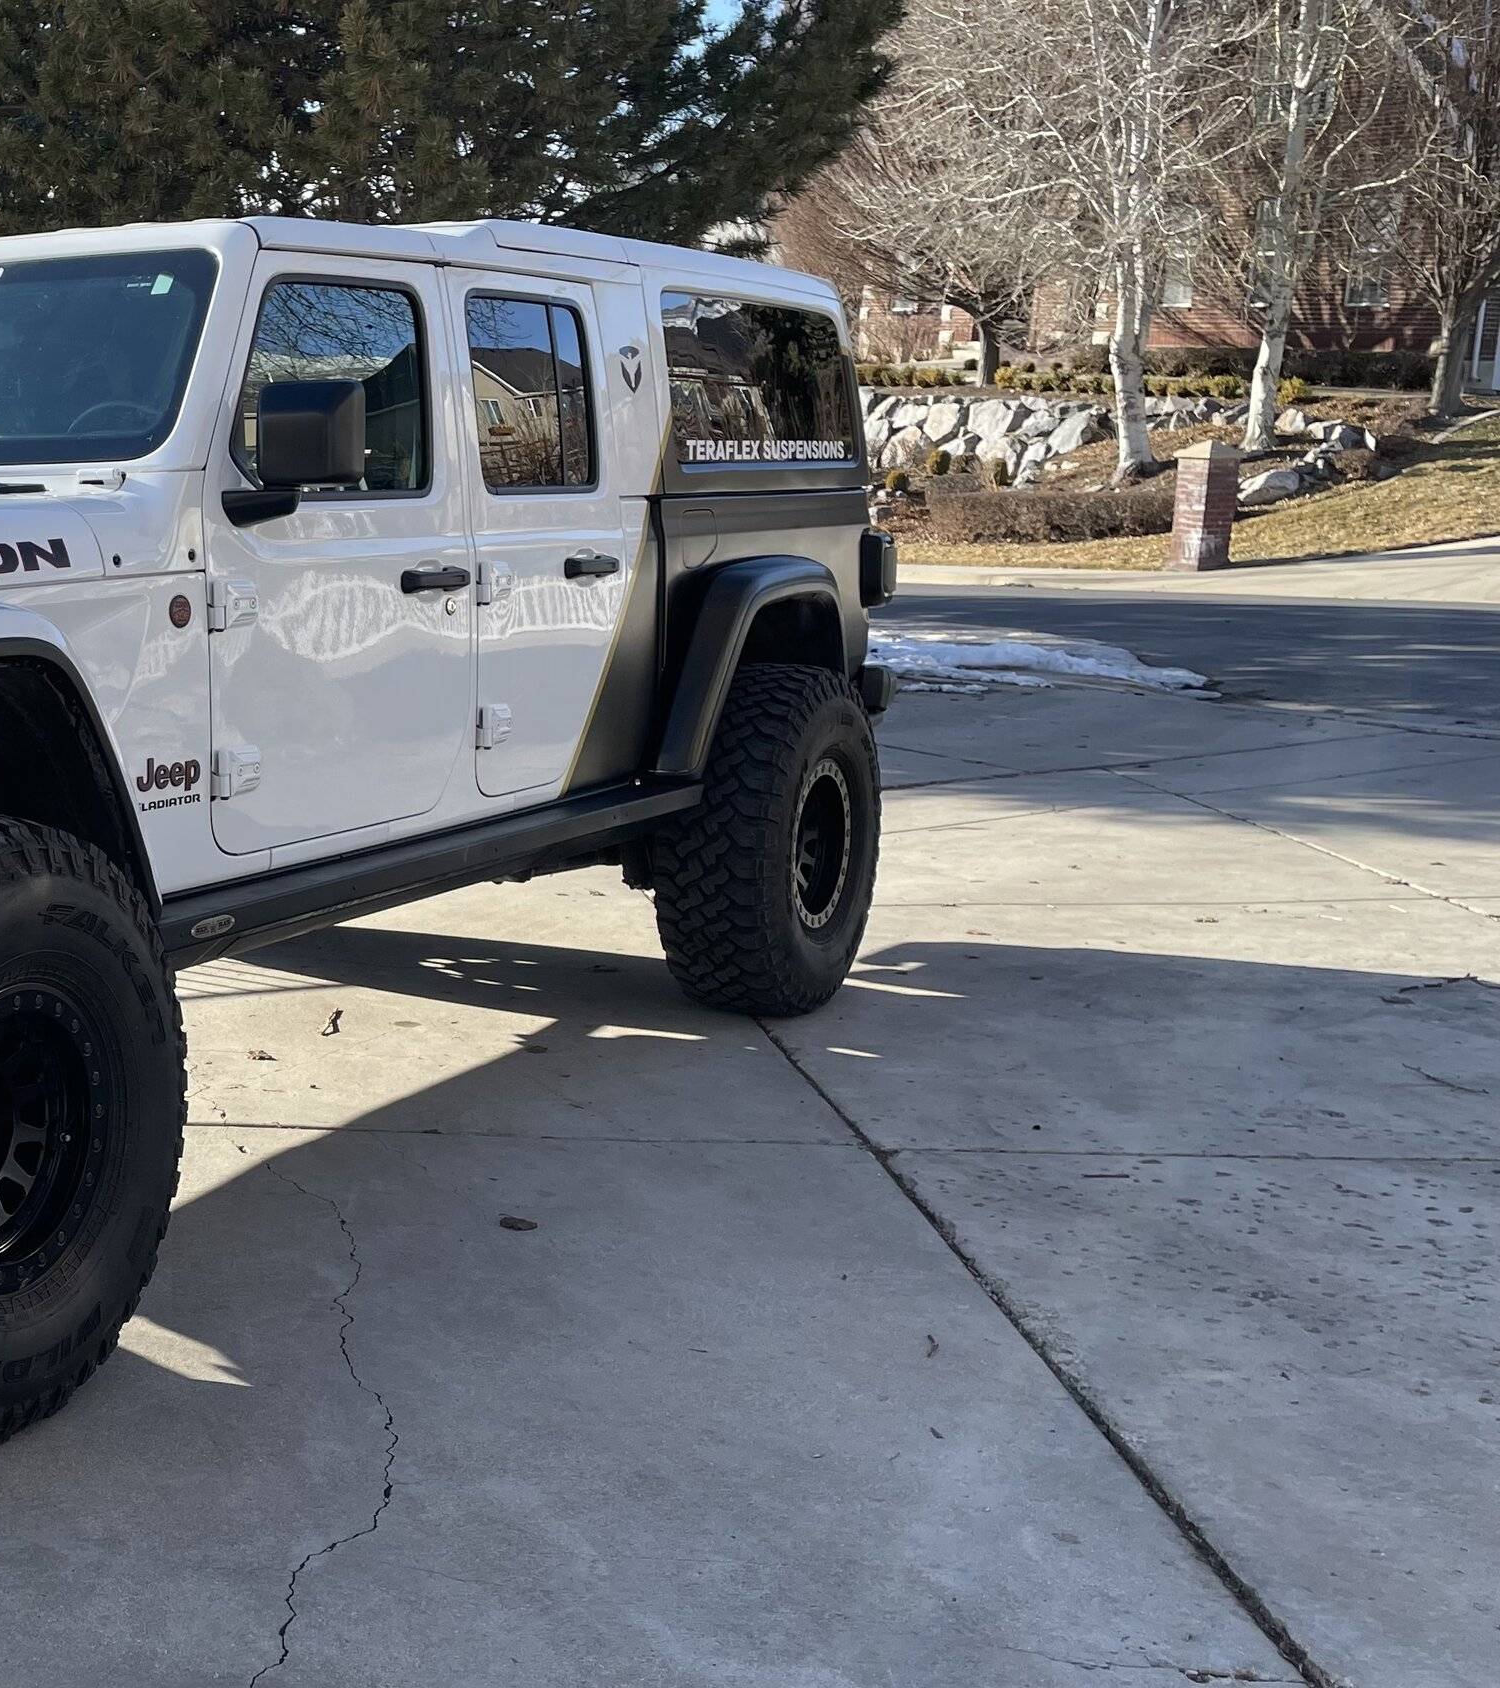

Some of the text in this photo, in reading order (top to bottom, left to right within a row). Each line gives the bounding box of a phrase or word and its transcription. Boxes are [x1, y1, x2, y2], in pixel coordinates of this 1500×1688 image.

[686, 439, 845, 461] TERAFLEX SUSPENSIONS
[136, 757, 201, 792] Jeep
[138, 793, 201, 812] LADIATOR
